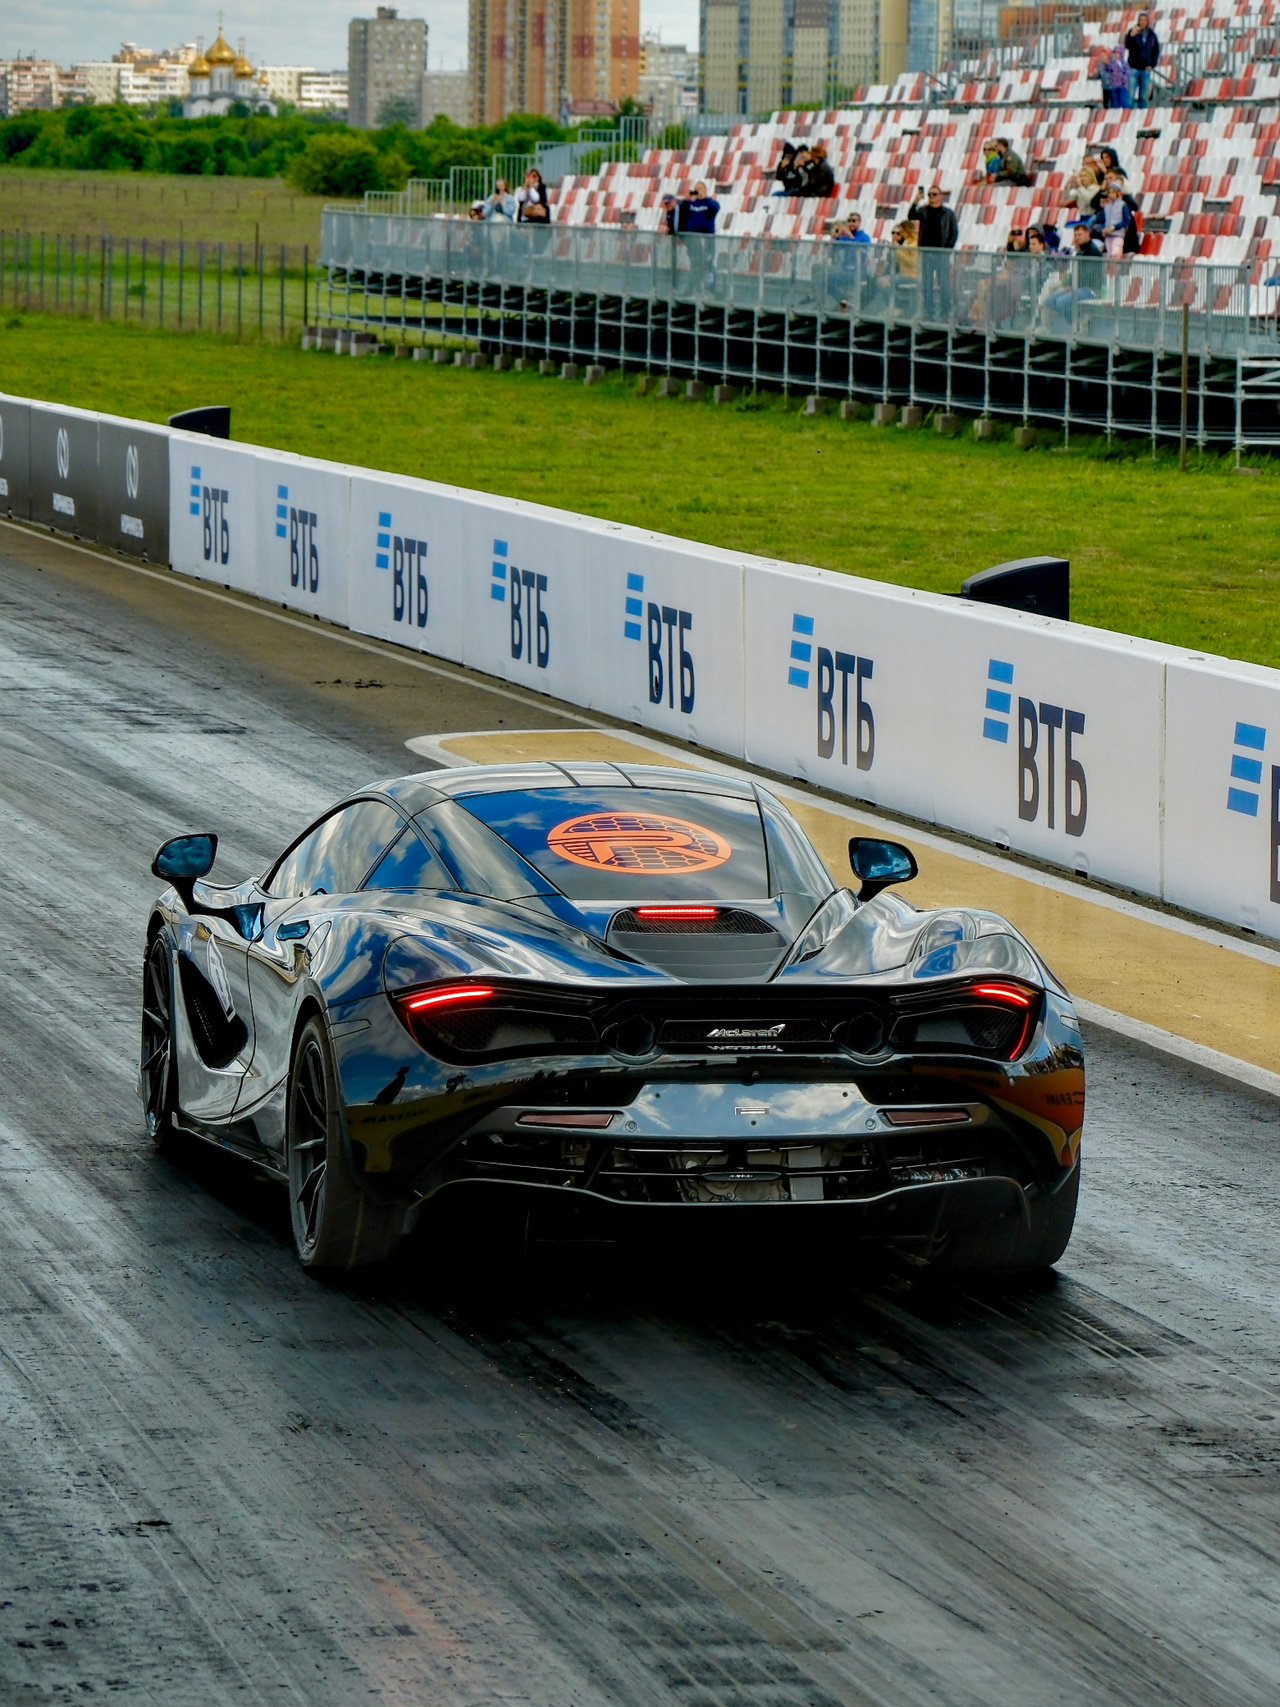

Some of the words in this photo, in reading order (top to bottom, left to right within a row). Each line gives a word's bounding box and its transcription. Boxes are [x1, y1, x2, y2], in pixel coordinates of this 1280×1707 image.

[204, 487, 230, 565] ВТБ
[291, 508, 318, 593] ВТБ
[394, 536, 428, 628] ВТБ
[511, 567, 549, 668] ВТБ
[648, 602, 694, 714] ВТБ
[818, 647, 874, 771] ВТБ
[1019, 697, 1087, 837] ВТБ
[707, 1028, 779, 1037] McLaren
